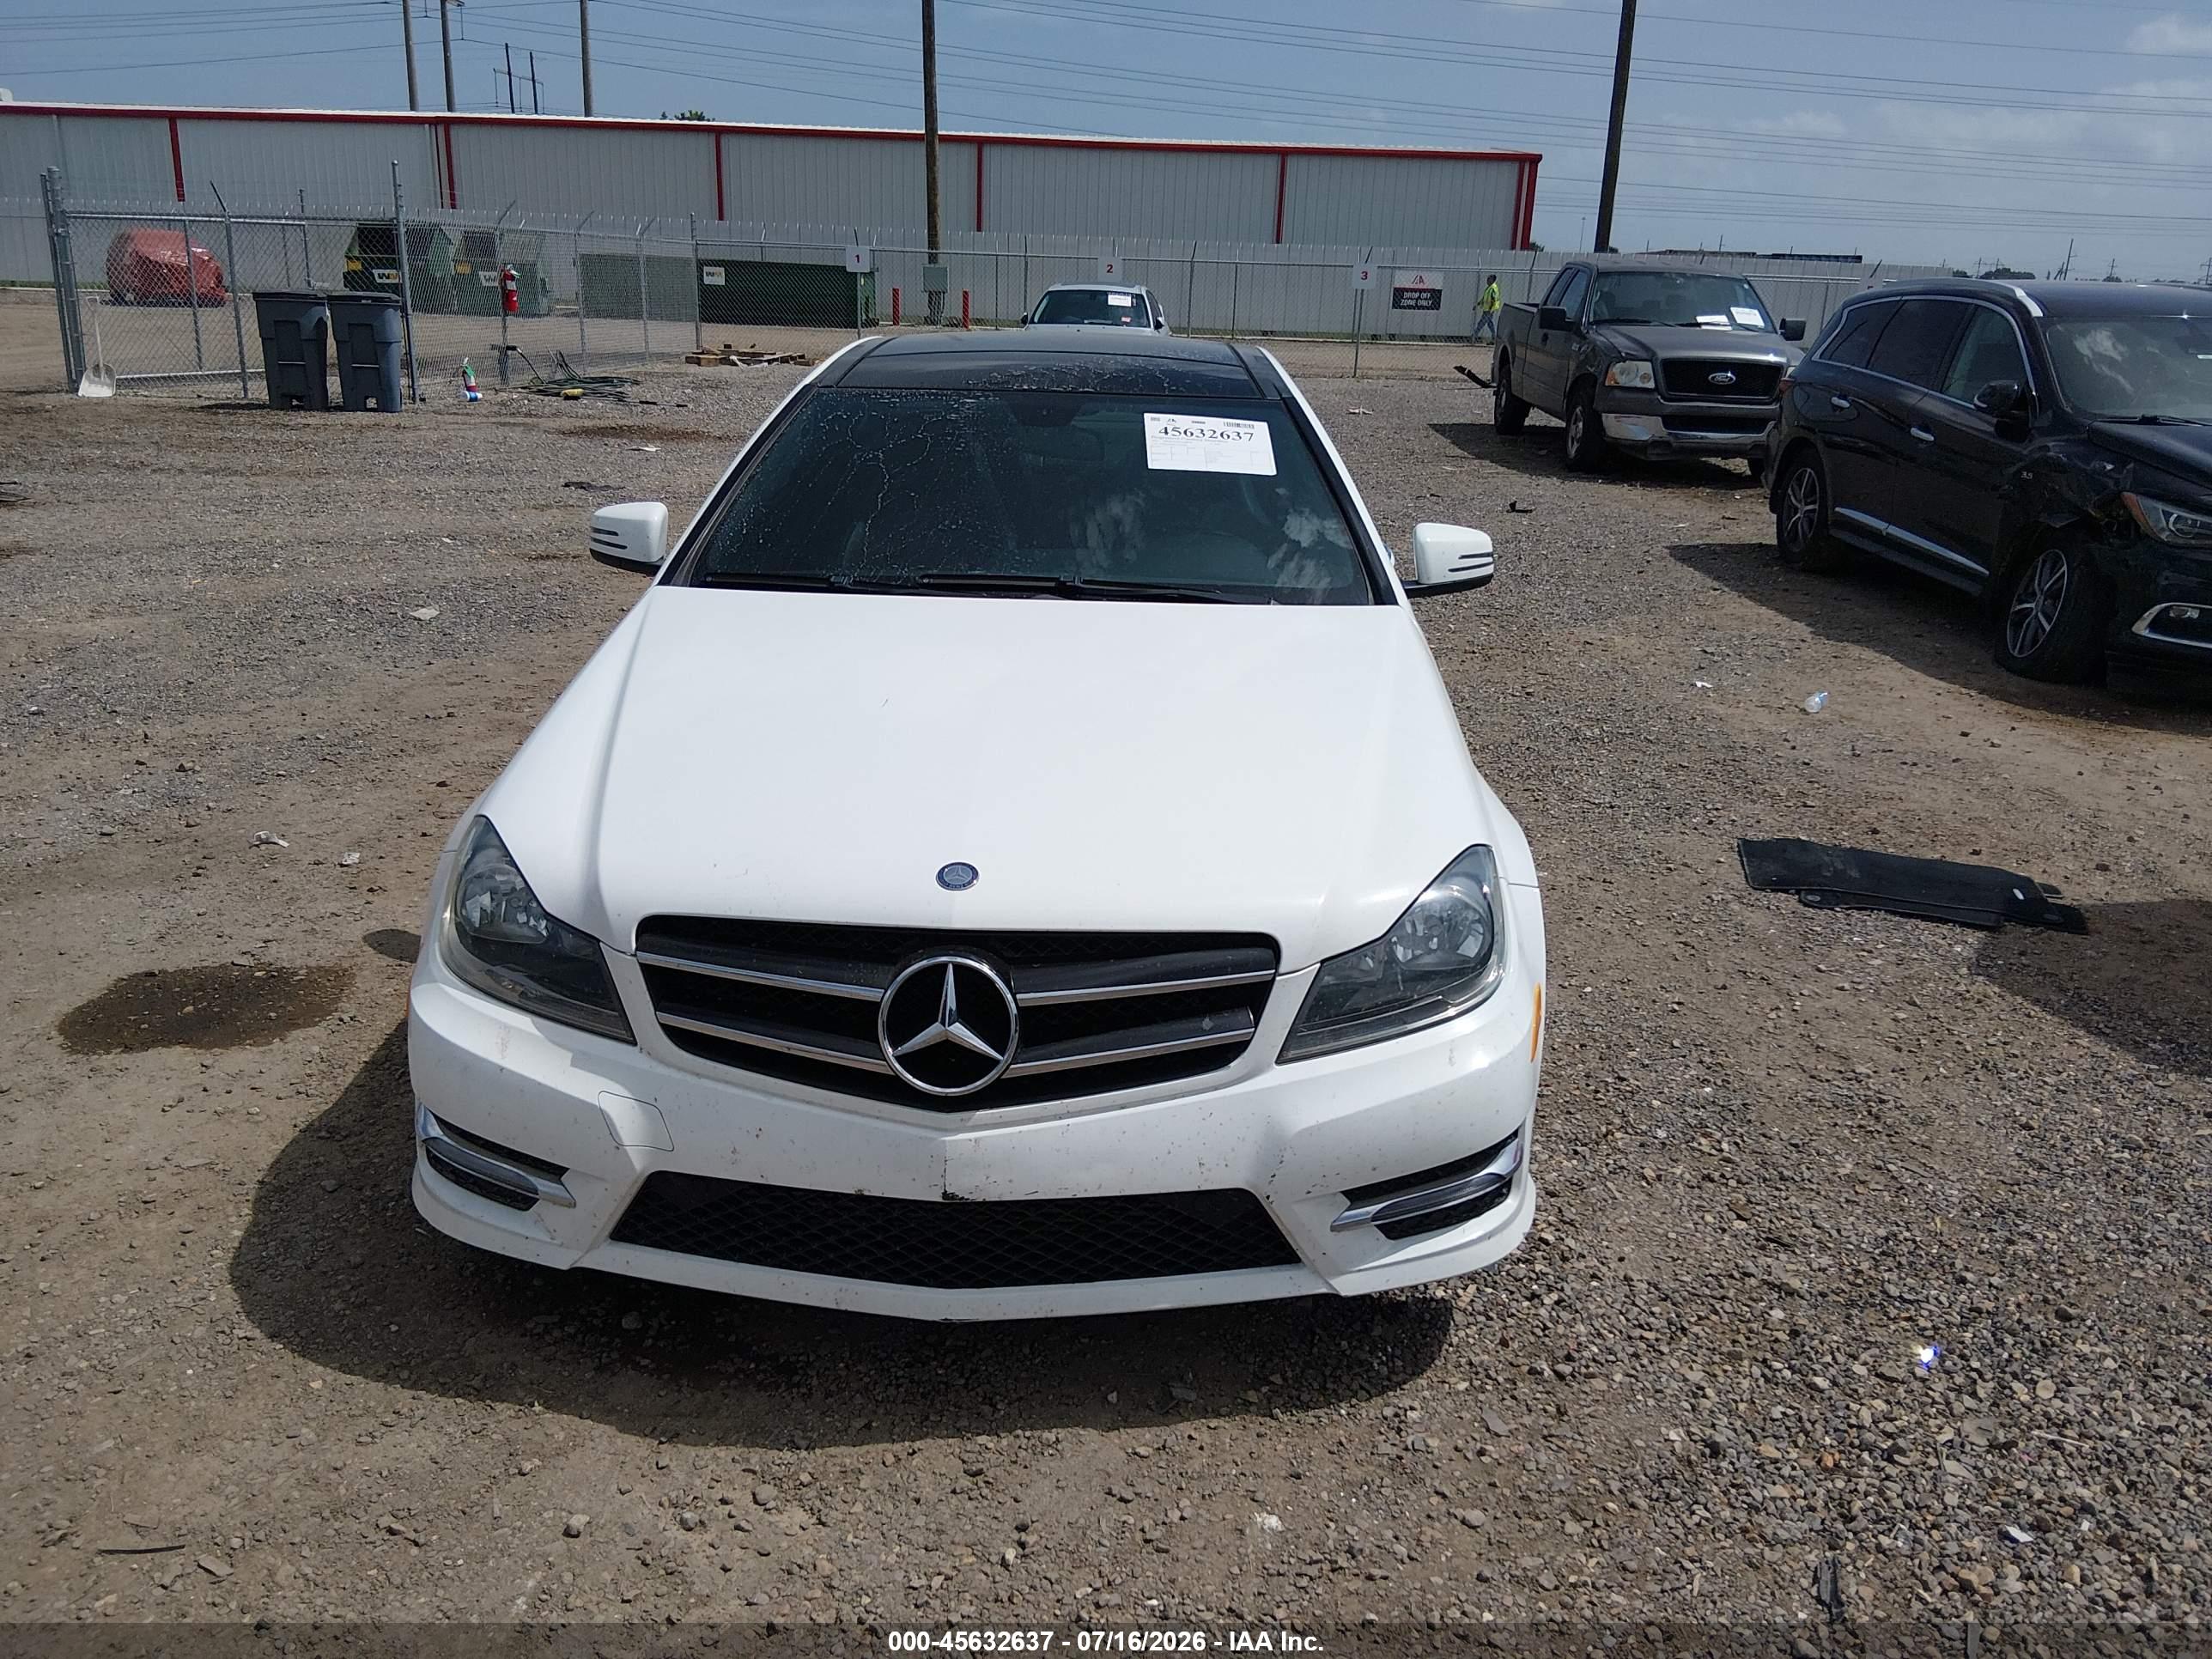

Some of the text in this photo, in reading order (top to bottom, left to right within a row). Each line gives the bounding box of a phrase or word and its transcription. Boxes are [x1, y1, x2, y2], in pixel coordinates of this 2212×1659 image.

[855, 254, 860, 264] 1
[1106, 264, 1114, 274] 2
[1360, 270, 1369, 281] 3
[1158, 425, 1255, 442] 45632637
